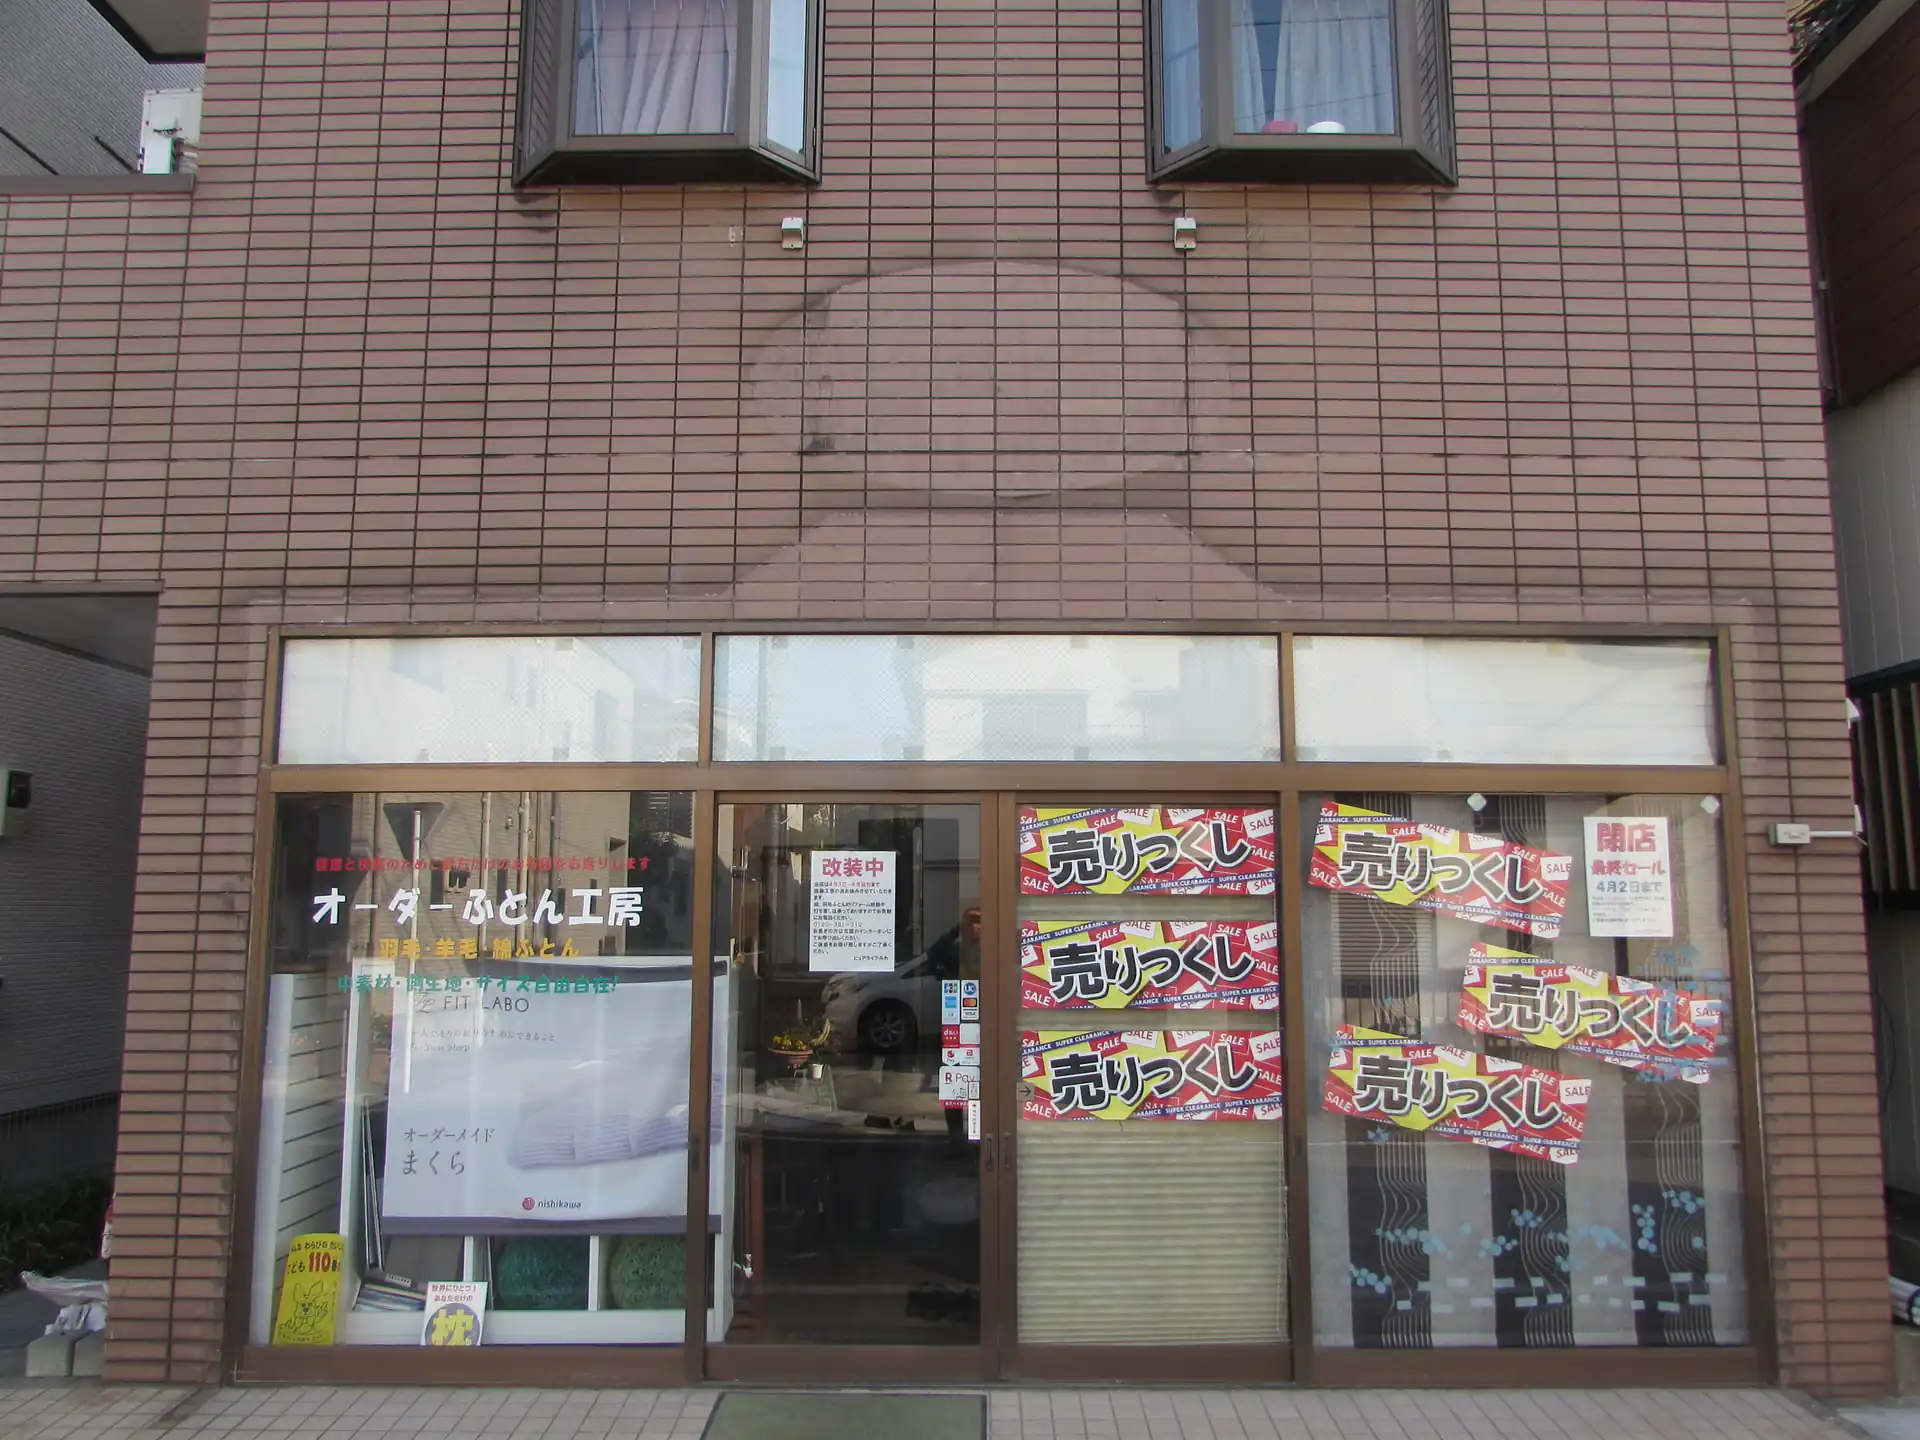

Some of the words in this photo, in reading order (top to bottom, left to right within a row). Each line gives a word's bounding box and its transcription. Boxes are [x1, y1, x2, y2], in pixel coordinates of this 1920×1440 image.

[1053, 816, 1071, 824] SUPER
[1093, 814, 1117, 829] SALE
[1213, 811, 1239, 824] SALE
[1393, 826, 1416, 836] SALE
[1596, 822, 1657, 852] 閉店
[1048, 820, 1251, 888] 売りつくし
[1511, 845, 1537, 863] SALE
[822, 857, 884, 878] 改装中
[1338, 830, 1543, 903] 売りつくし
[1591, 859, 1666, 876] 最終セール
[1023, 876, 1050, 892] SALE
[1311, 866, 1337, 888] SALE
[1596, 880, 1663, 893] 4月2日まで
[312, 886, 644, 926] オーダーふとん工房
[1054, 929, 1073, 937] SUPER
[1095, 927, 1119, 942] SALE
[1215, 924, 1242, 937] SALE
[378, 937, 581, 960] 羽毛・羊毛・綿ふとん
[1049, 933, 1255, 1002] 売りつくし
[1541, 968, 1564, 978] SALE
[443, 995, 471, 1011] FIT
[482, 996, 530, 1013] LABO
[1024, 989, 1051, 1006] SALE
[1486, 971, 1693, 1048] 売りつくし
[1459, 1008, 1486, 1030] SALE
[1055, 1038, 1074, 1047] SUPER
[1096, 1037, 1120, 1052] SALE
[1218, 1033, 1245, 1046] SALE
[1408, 1049, 1432, 1059] SALE
[945, 1072, 953, 1084] R
[1050, 1043, 1258, 1114] 売りつくし
[1529, 1068, 1556, 1086] SALE
[1353, 1053, 1562, 1128] 売りつくし
[1025, 1101, 1052, 1118] SALE
[1326, 1091, 1353, 1113] SALE
[402, 1126, 496, 1144] オーダーメイド
[401, 1150, 467, 1175] まくら
[537, 1198, 582, 1210] nishikawa
[308, 1251, 331, 1273] 110
[431, 1309, 475, 1346] 枕
